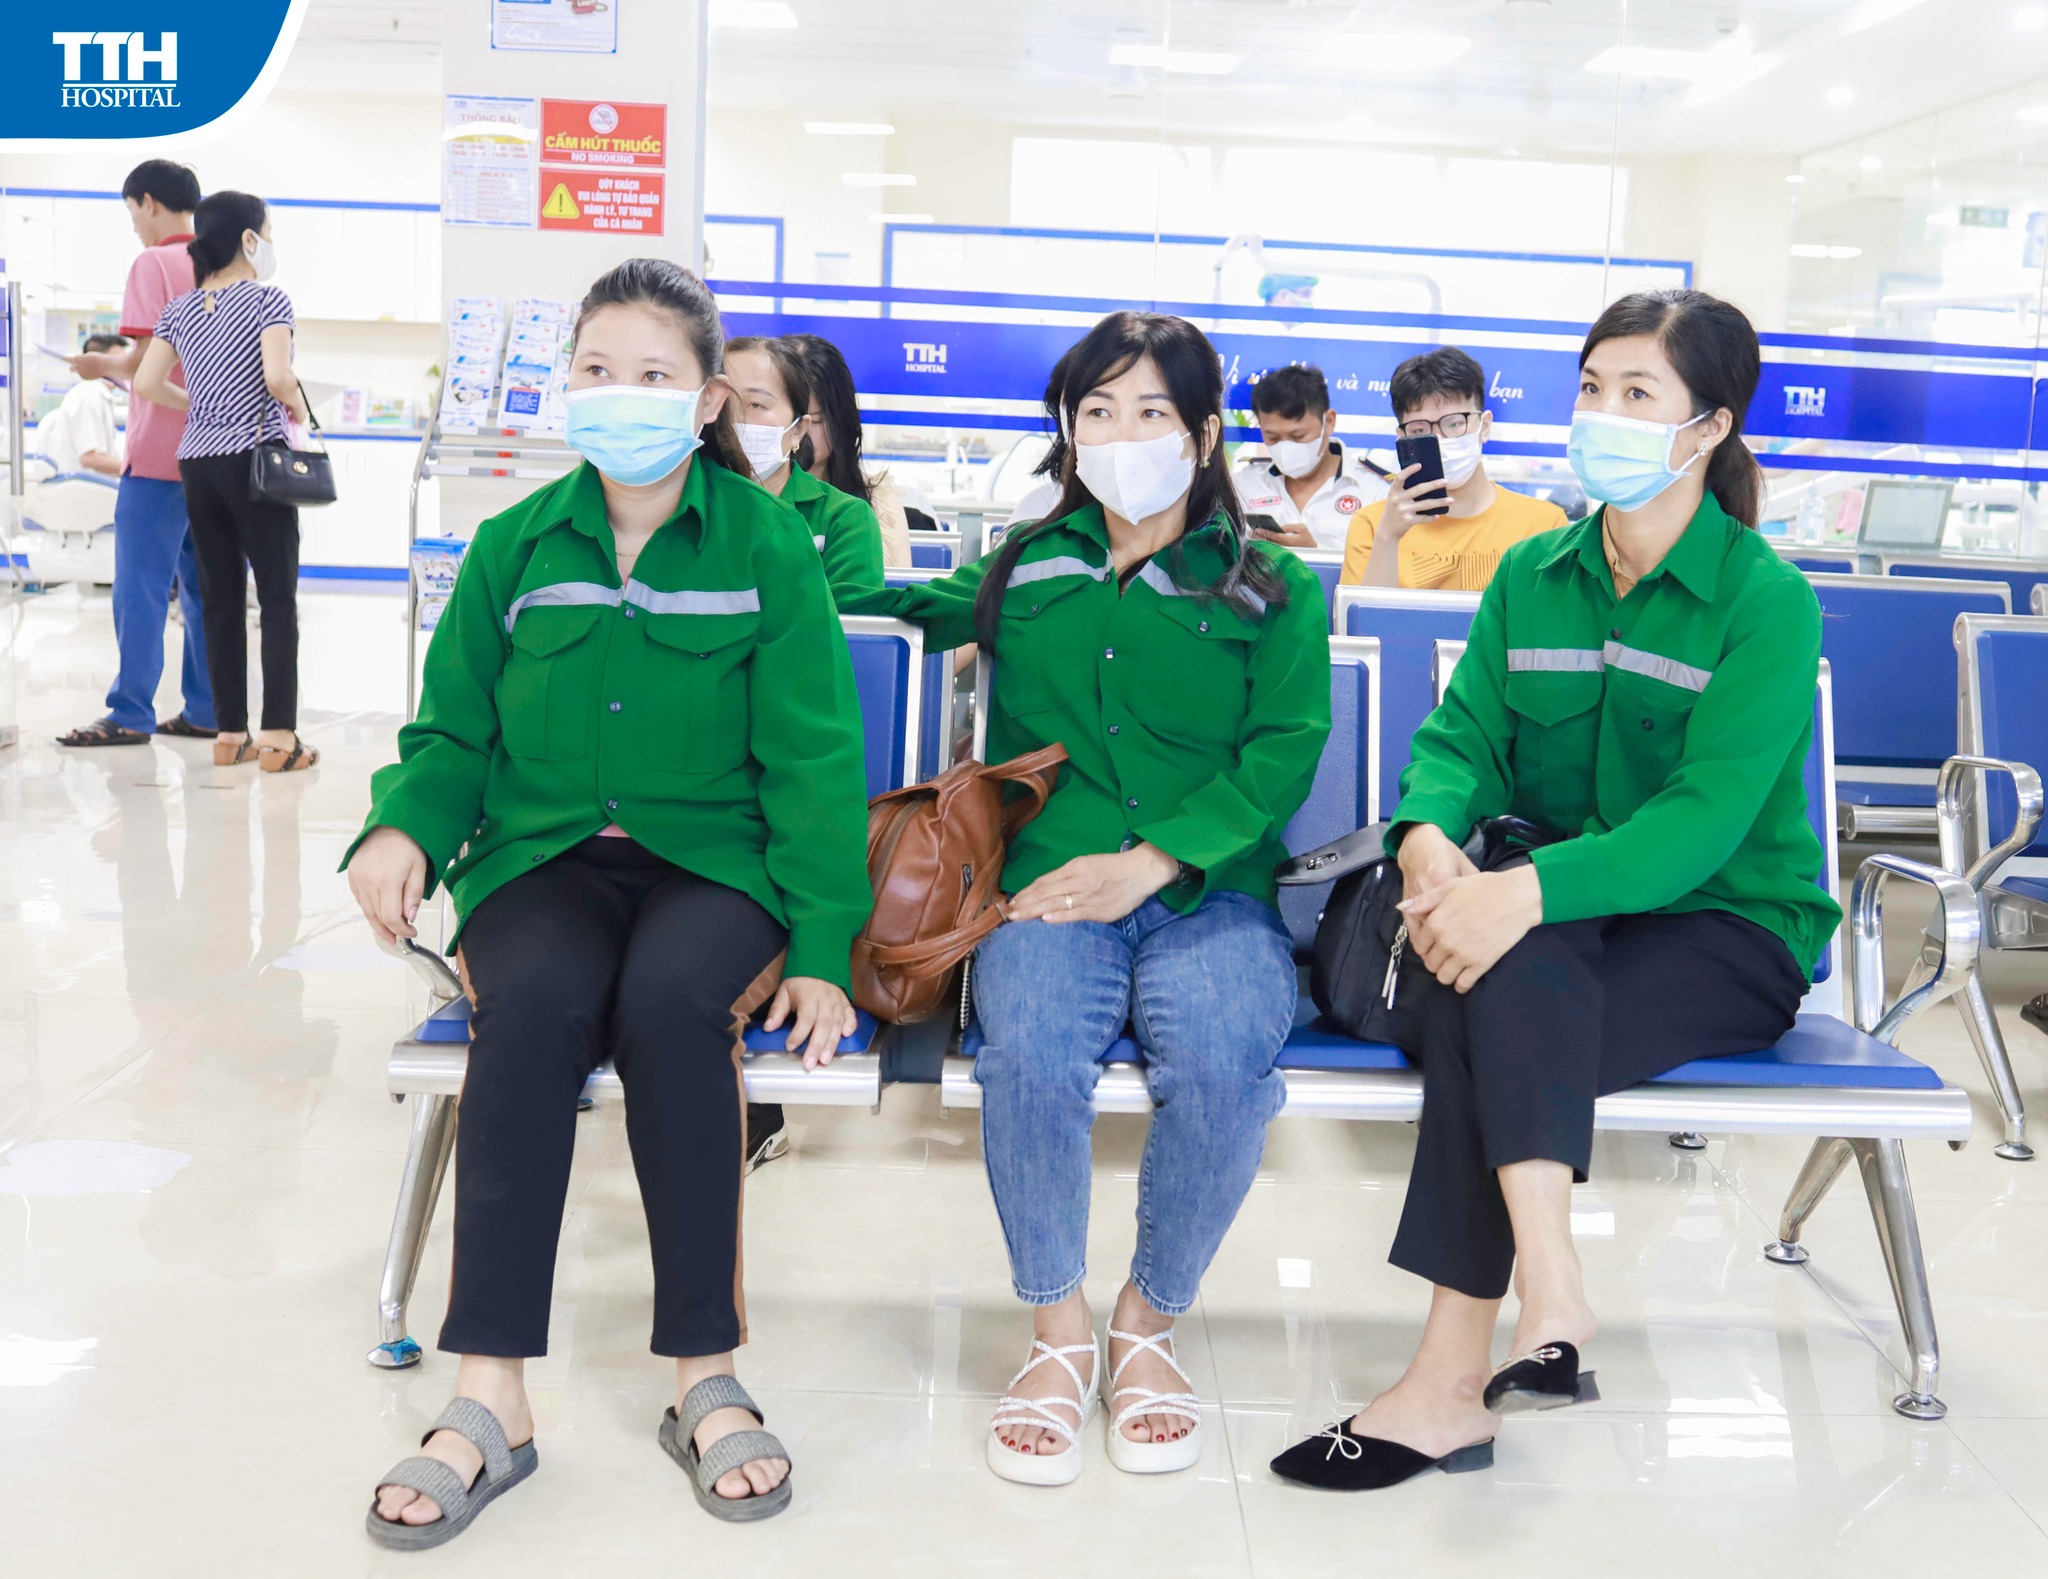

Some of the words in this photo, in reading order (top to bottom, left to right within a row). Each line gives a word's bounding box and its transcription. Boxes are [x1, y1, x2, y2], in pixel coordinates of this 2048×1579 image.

[545, 131, 578, 149] CẤM
[580, 135, 610, 151] HÚT
[611, 135, 662, 153] THUỐC
[571, 152, 587, 163] NO
[587, 153, 635, 165] SMOKING
[614, 178, 640, 191] KHÁCH
[577, 190, 591, 202] VUI
[591, 189, 611, 203] LÒNG
[629, 206, 653, 218] TRANG
[593, 215, 609, 229] CỦA
[609, 217, 620, 229] CÁ
[903, 343, 947, 363] TTH
[905, 363, 947, 374] HOSPITAL
[1336, 373, 1359, 390] và
[1489, 371, 1524, 403] bạn
[1783, 386, 1826, 406] TTH
